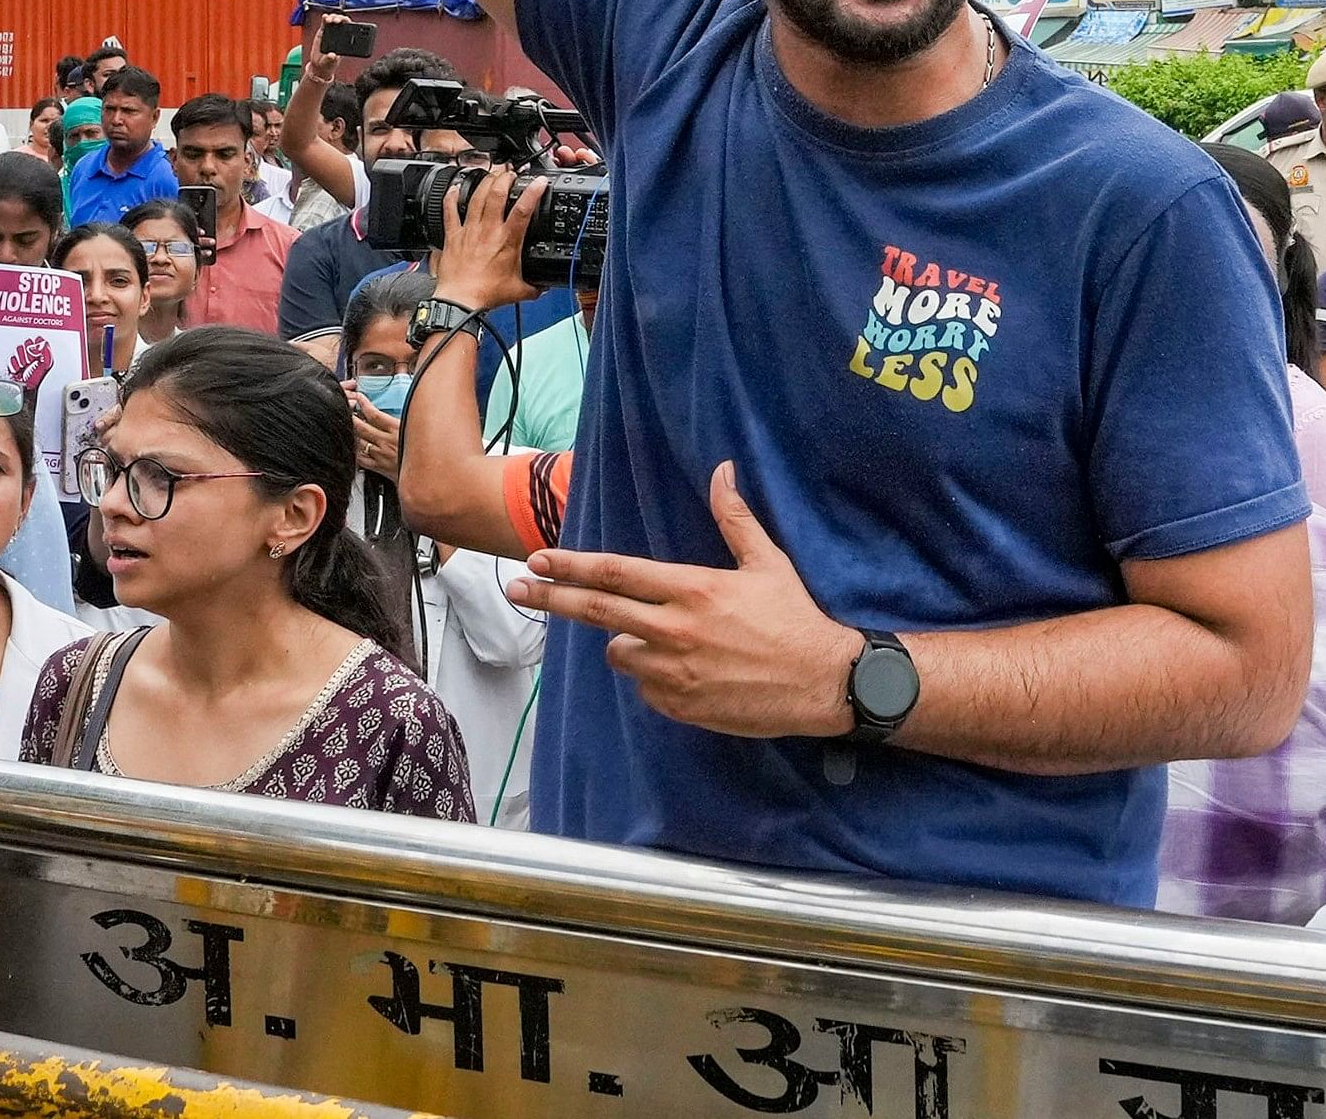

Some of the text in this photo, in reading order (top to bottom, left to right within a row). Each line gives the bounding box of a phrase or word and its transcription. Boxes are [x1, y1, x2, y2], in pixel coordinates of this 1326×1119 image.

[18, 272, 61, 295] STOP
[881, 245, 1003, 304] TRAVEL
[2, 315, 64, 327] AGAINST DOCTORS
[873, 275, 1002, 337] MORE
[863, 309, 990, 362] WORRY
[849, 335, 978, 413] LESS
